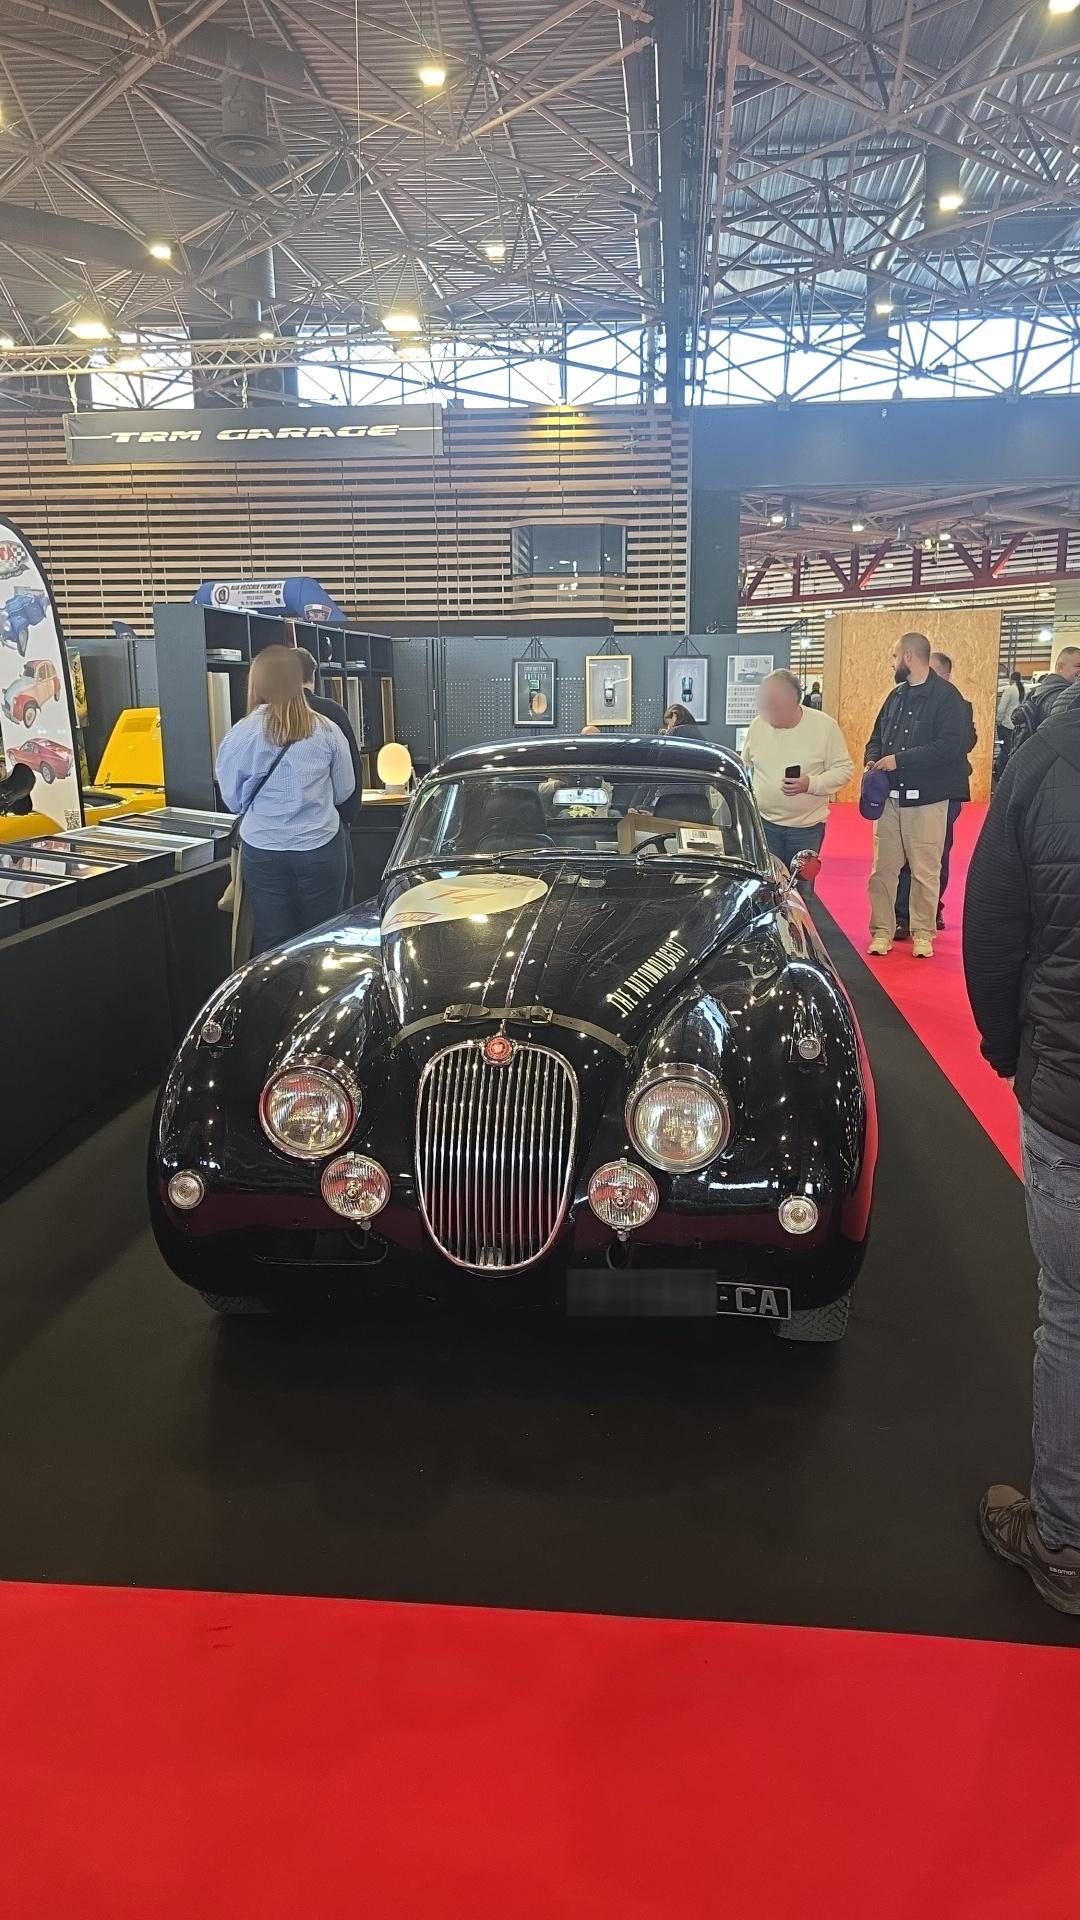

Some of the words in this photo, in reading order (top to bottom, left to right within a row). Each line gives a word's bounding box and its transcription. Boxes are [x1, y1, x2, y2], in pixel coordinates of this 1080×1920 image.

[112, 430, 201, 443] TRM
[216, 424, 400, 441] GARAGE
[607, 987, 639, 1016] THE
[624, 939, 688, 998] AUTOMOLOGIST
